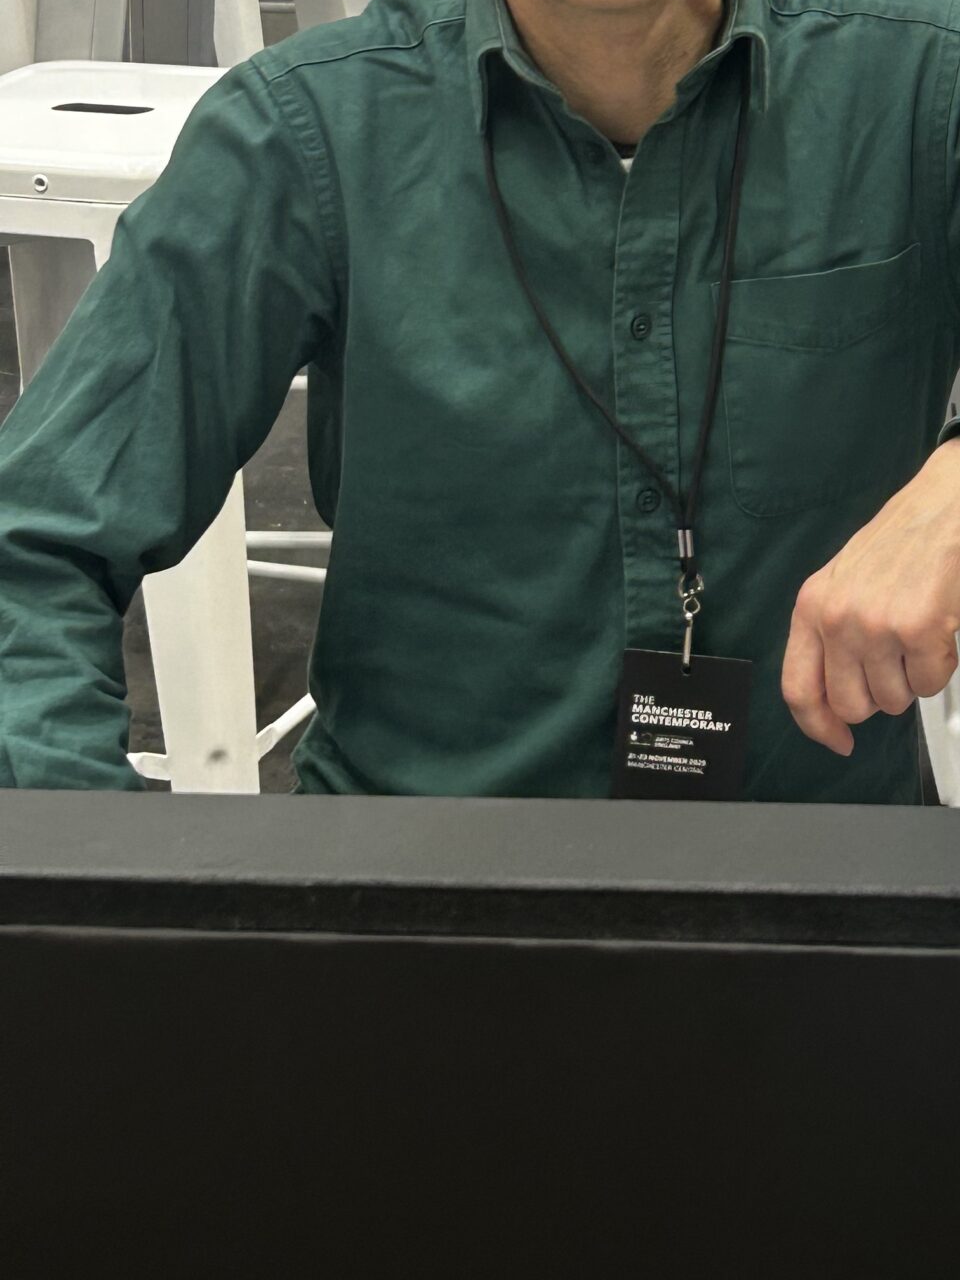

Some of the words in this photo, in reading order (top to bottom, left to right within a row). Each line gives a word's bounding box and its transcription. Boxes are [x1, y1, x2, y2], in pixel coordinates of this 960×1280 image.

[633, 694, 655, 705] THE
[632, 704, 713, 721] MANCHESTER
[631, 714, 731, 732] CONTEMPORARY
